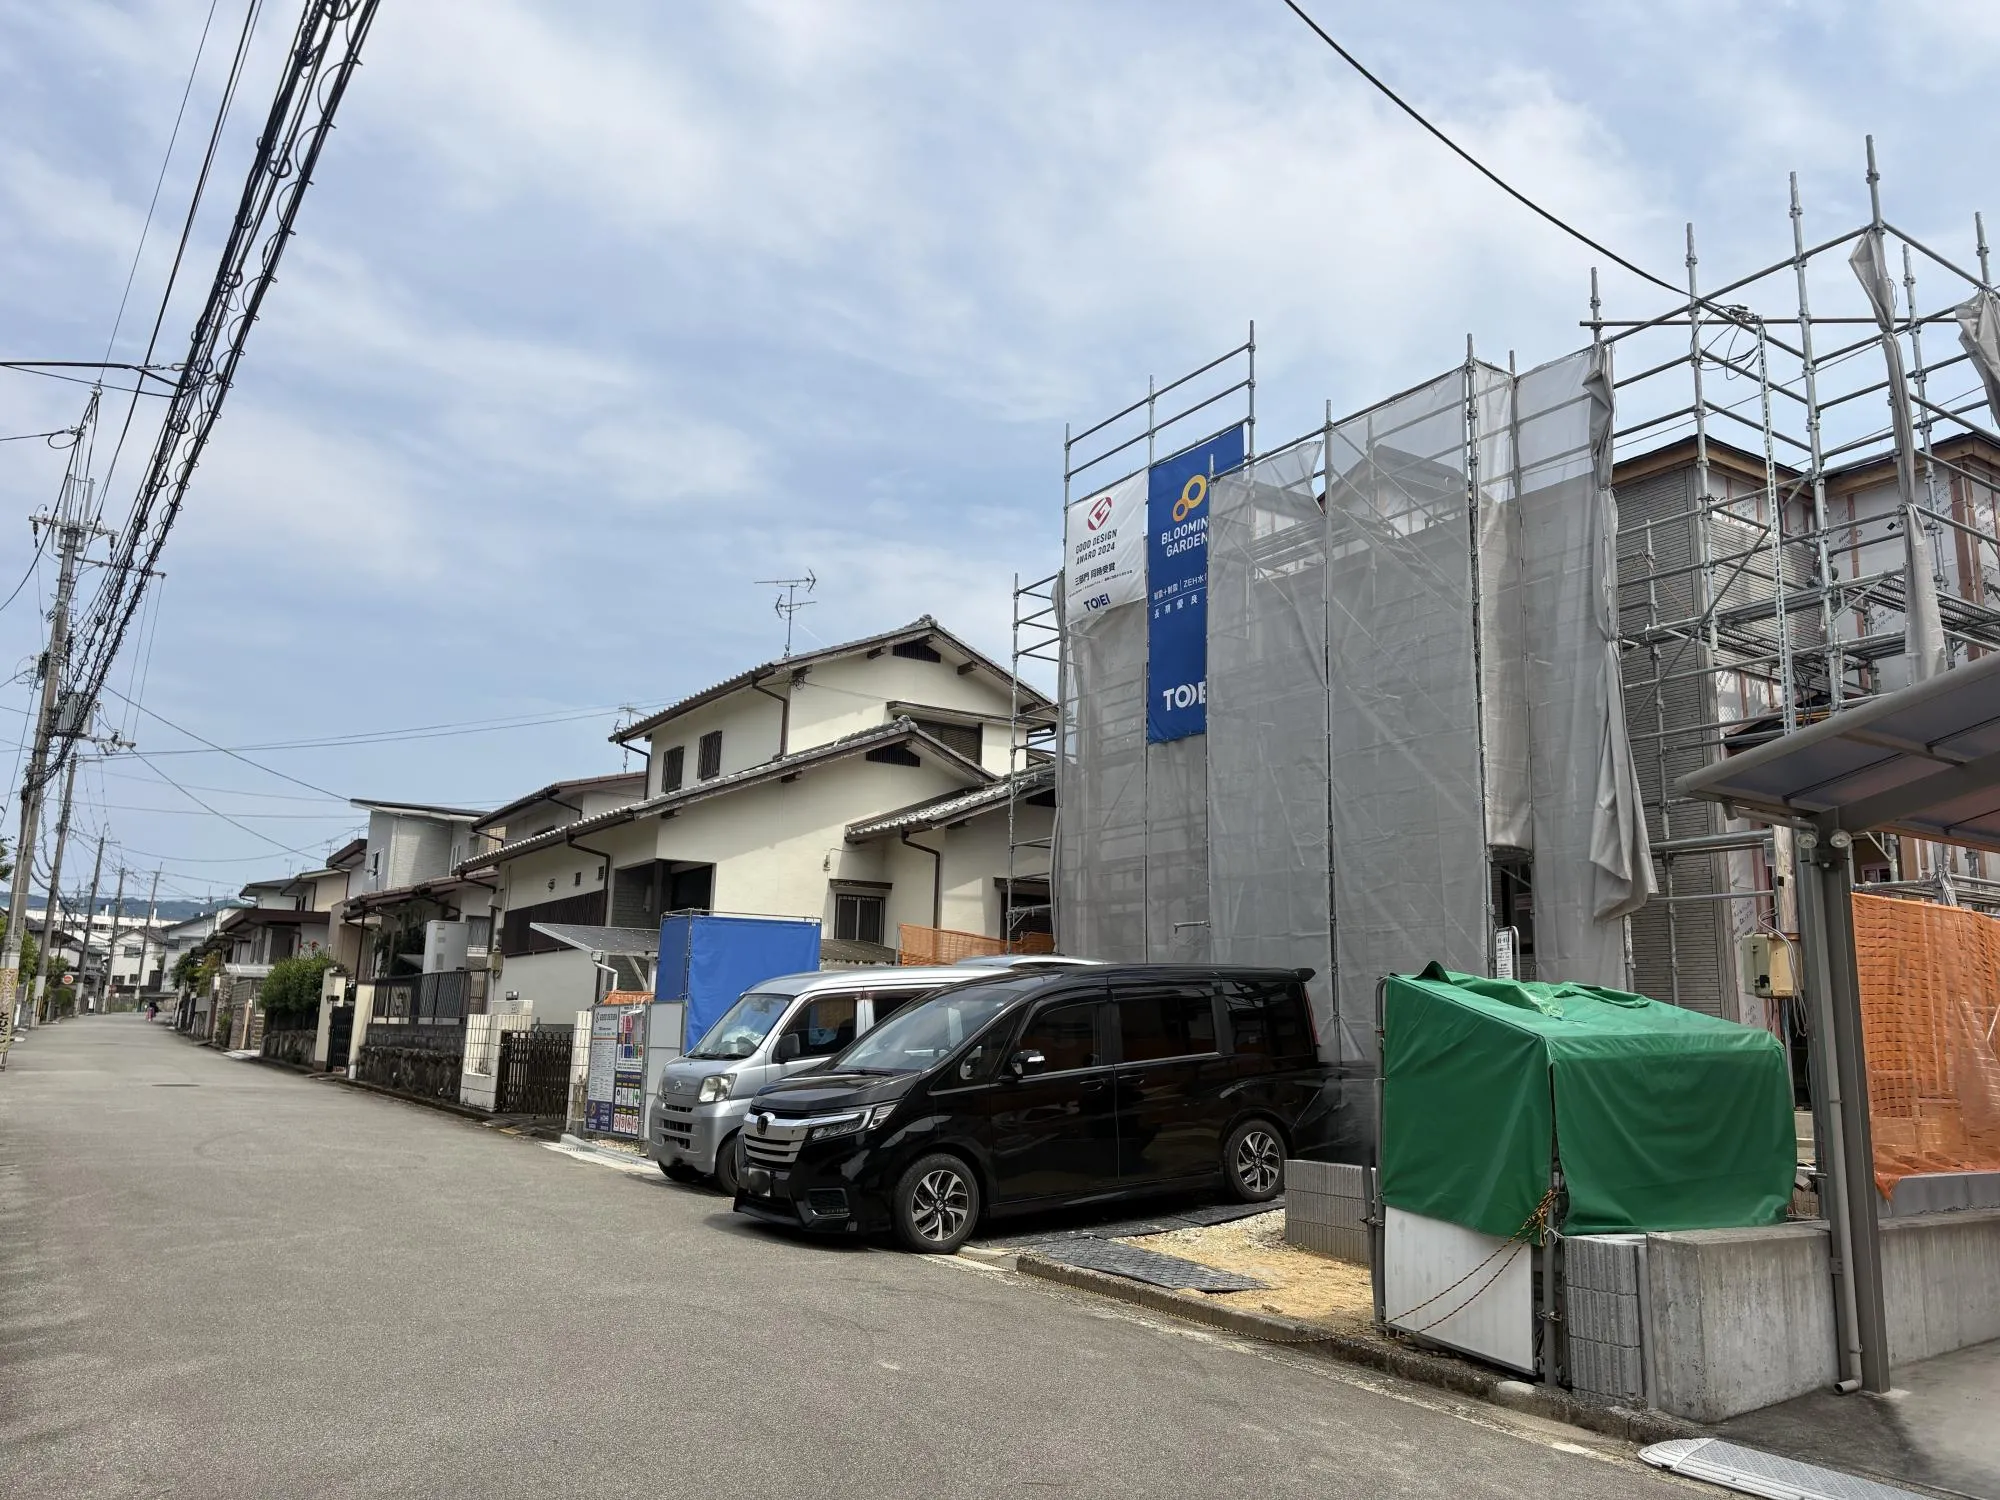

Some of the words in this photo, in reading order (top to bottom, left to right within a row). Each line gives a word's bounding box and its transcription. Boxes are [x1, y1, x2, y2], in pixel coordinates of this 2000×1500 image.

[1075, 540, 1092, 555] GOOD
[1092, 528, 1118, 547] DESIGN
[1161, 516, 1208, 545] BLOOMIN
[1076, 549, 1097, 566] AWARD
[1098, 542, 1116, 556] 2024
[1166, 532, 1208, 557] GARDEN
[1163, 681, 1206, 711] TOE
